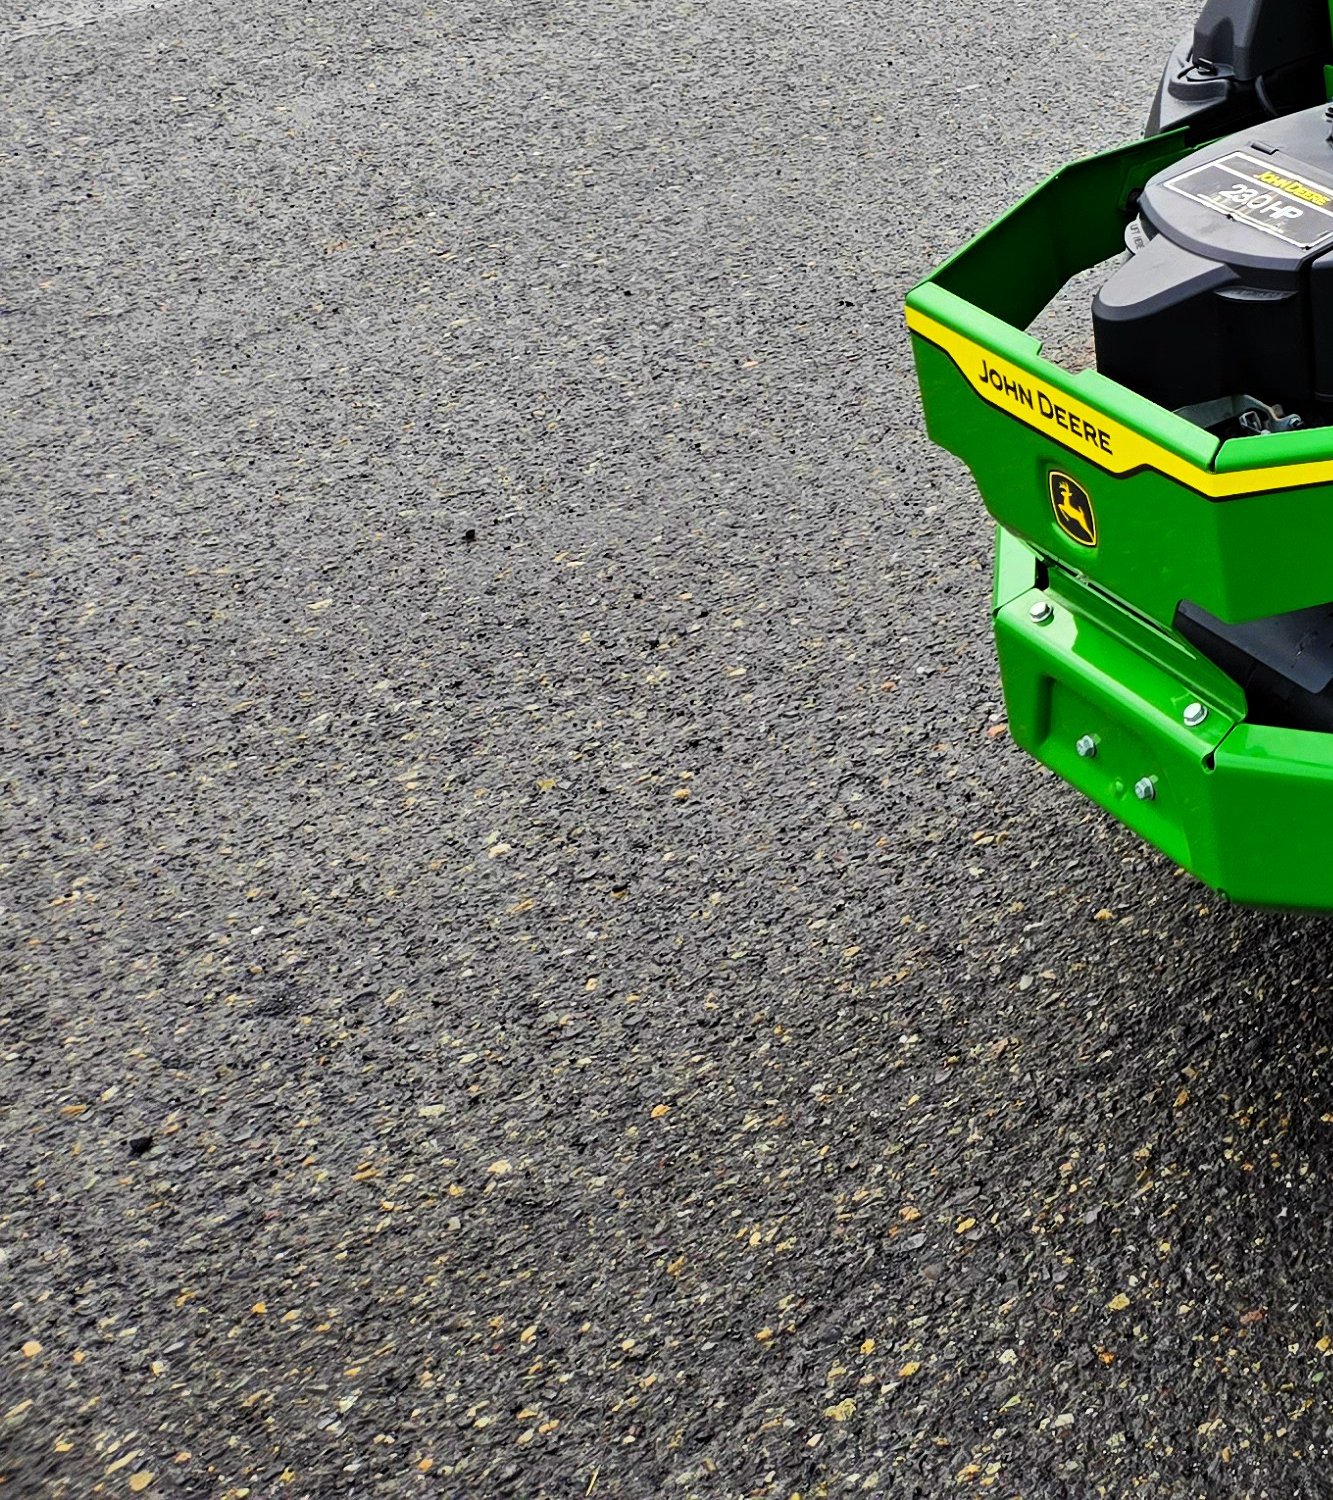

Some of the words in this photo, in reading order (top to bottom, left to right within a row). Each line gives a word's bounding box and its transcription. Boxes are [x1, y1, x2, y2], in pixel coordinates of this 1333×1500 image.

[1253, 171, 1292, 190] JOHN
[1284, 181, 1332, 206] DEERE
[1259, 200, 1304, 220] HP
[978, 359, 1035, 411] JOHN
[1037, 389, 1113, 456] DEERE
